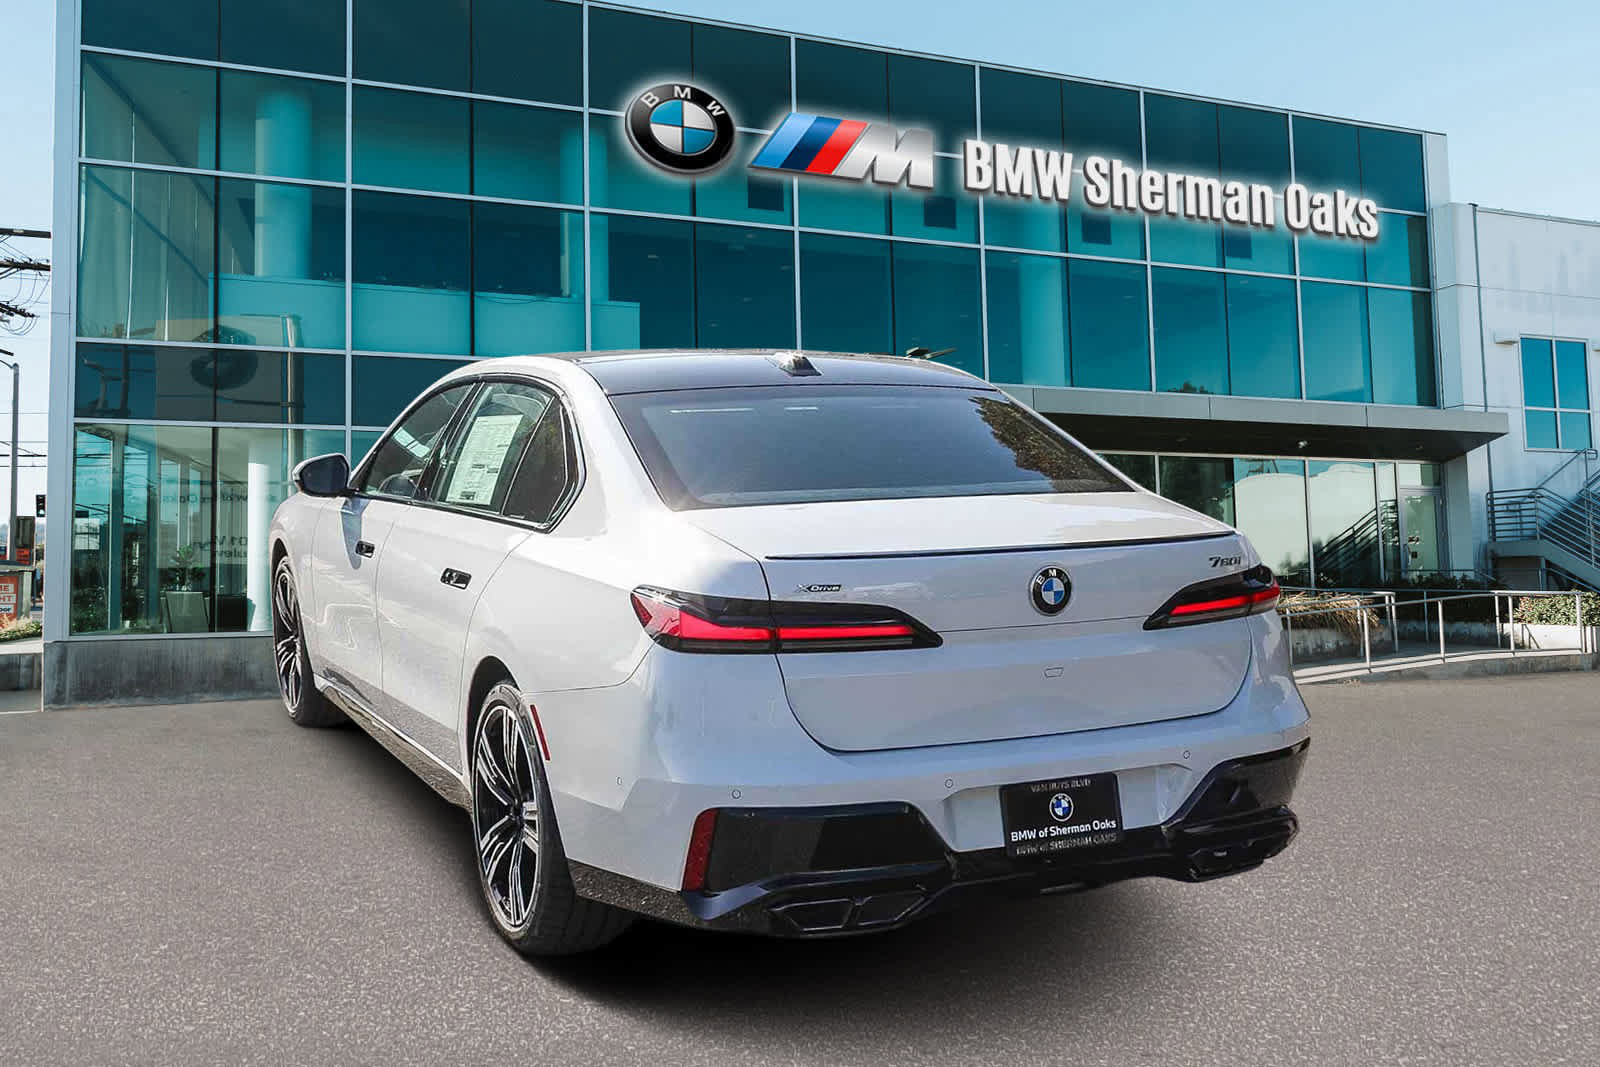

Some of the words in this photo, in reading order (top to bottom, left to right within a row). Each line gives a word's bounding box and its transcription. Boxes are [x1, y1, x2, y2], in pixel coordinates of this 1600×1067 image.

[641, 85, 725, 117] BMW
[963, 139, 1073, 200] BMW
[1083, 155, 1275, 227] Sherman
[1283, 183, 1380, 241] Oaks
[1011, 829, 1036, 841] BMW
[1039, 829, 1048, 838] of
[1049, 823, 1091, 837] Sherman
[1092, 819, 1117, 831] Oaks
